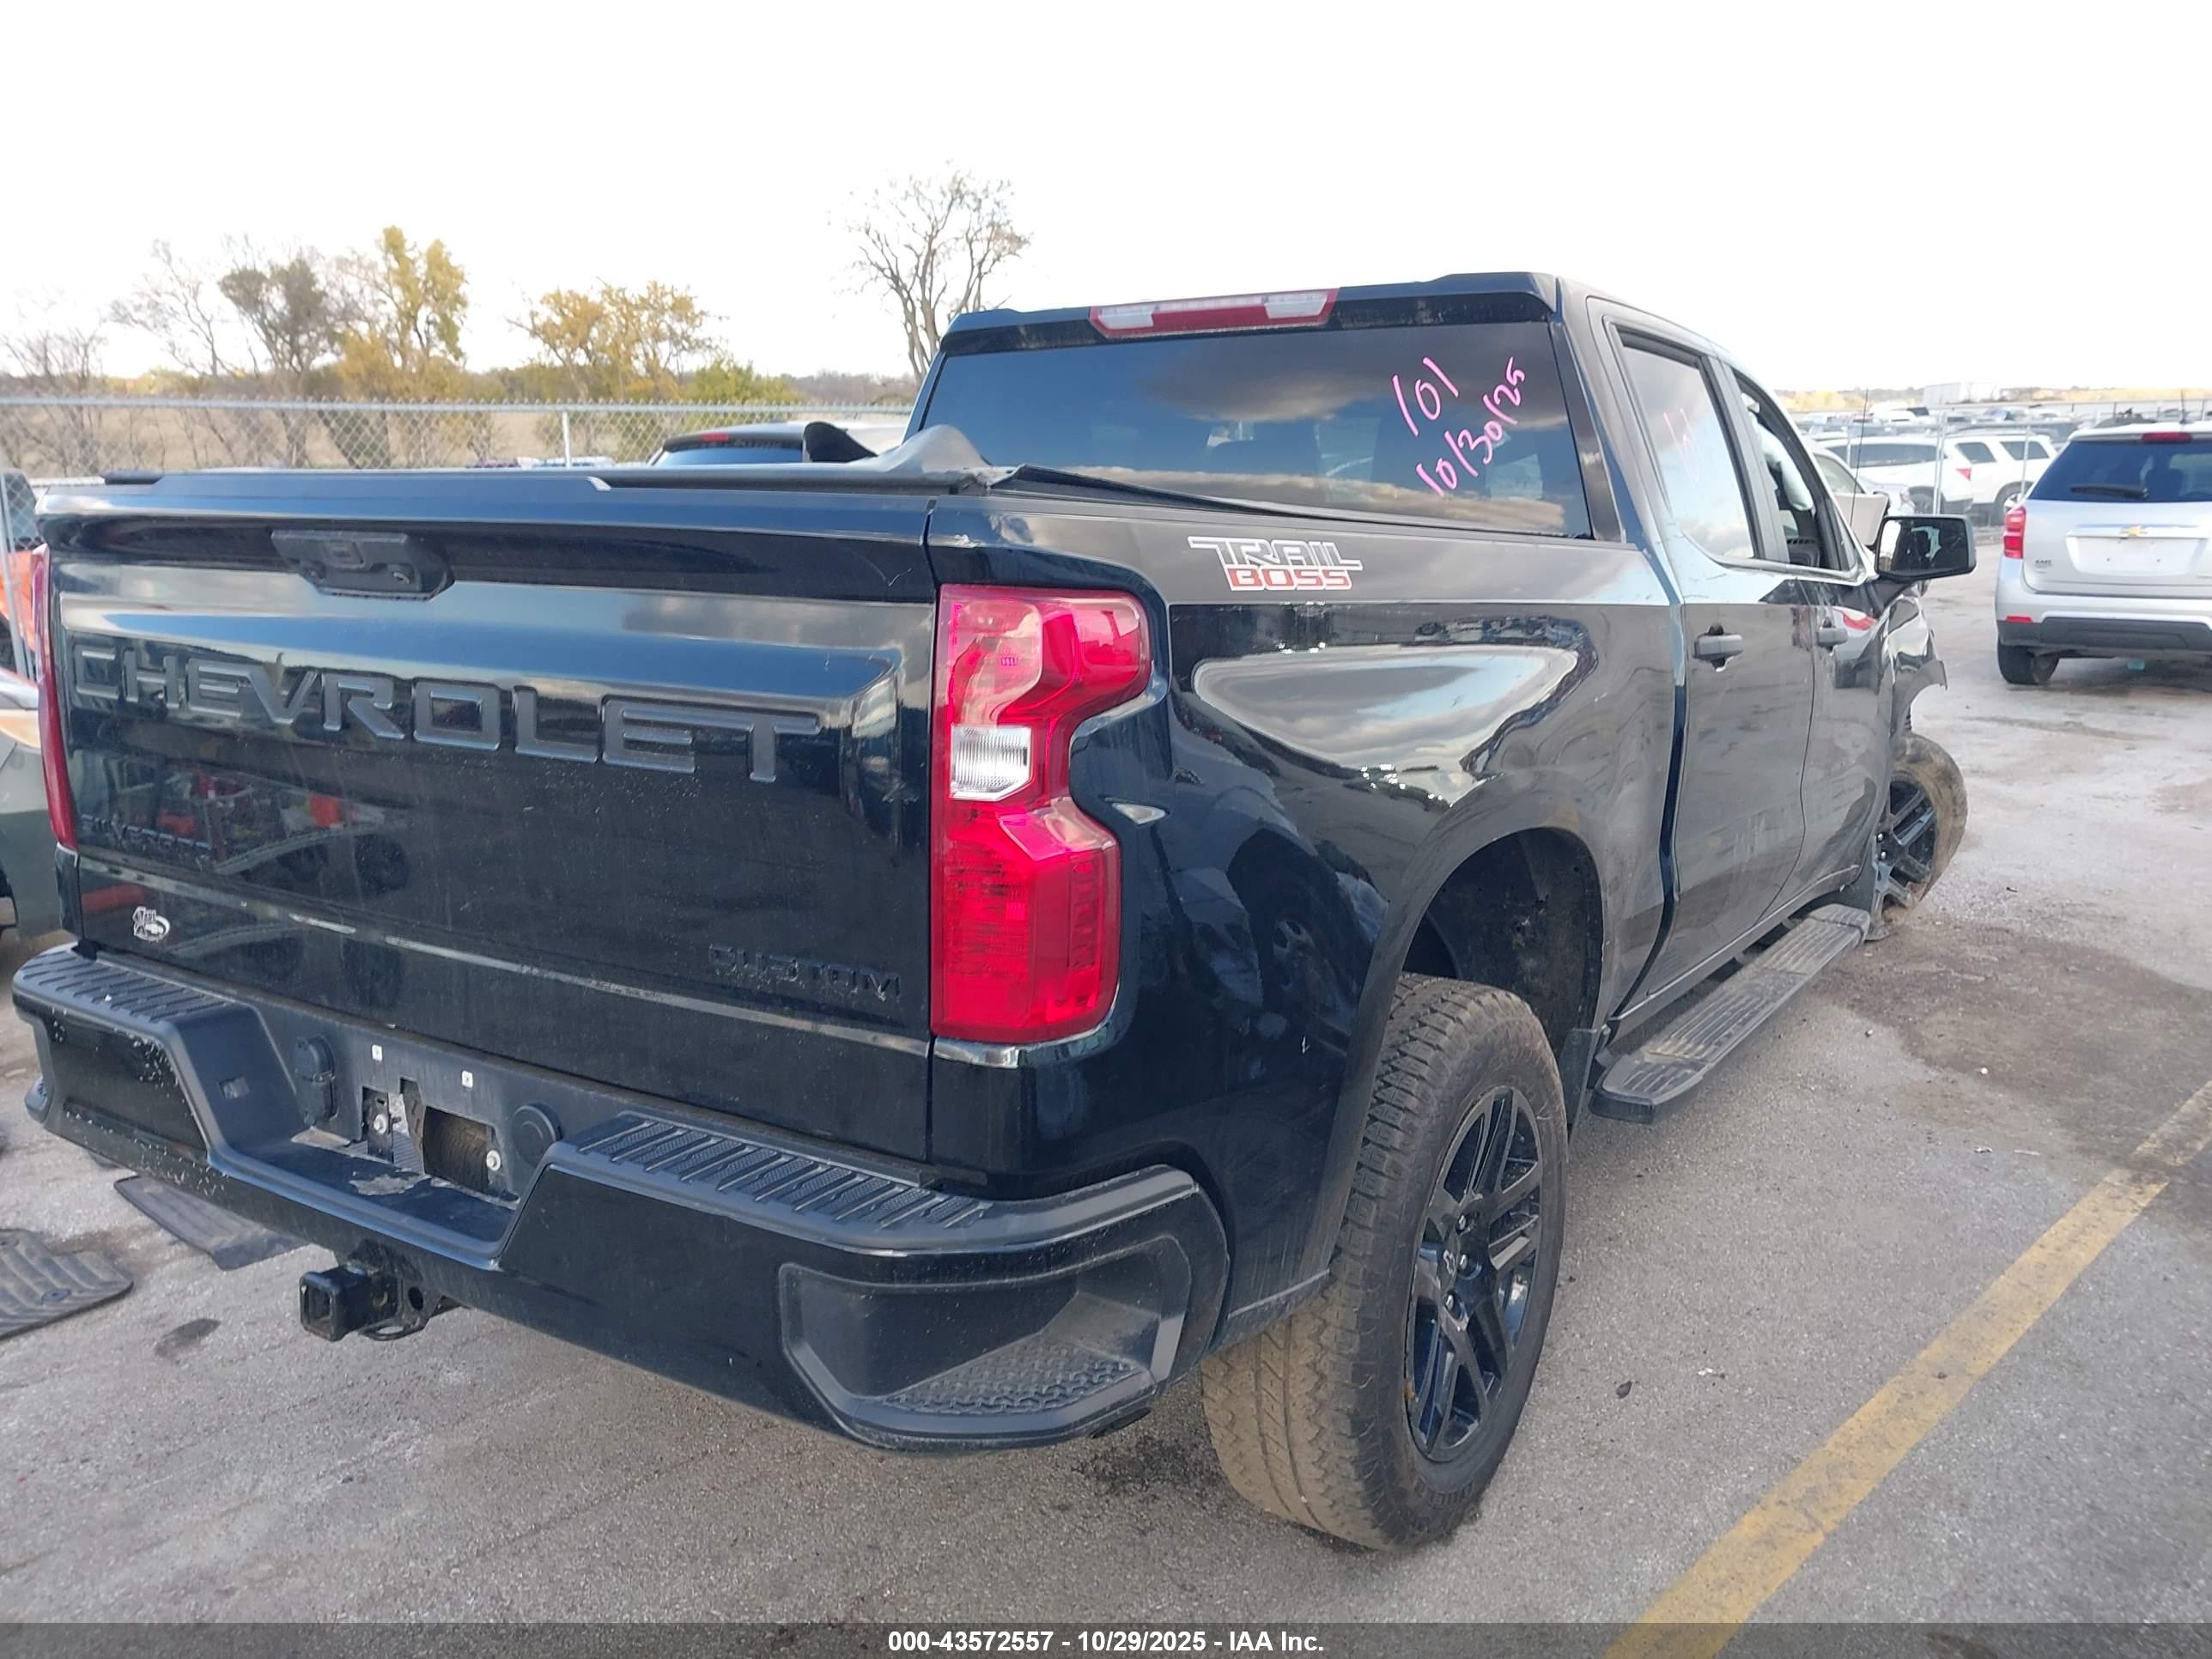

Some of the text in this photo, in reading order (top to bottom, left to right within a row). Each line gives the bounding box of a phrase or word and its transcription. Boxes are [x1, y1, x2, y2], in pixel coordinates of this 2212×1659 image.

[1392, 356, 1459, 436] 101
[1416, 356, 1525, 497] 10/30/25
[1188, 536, 1364, 570] TRAIL
[1225, 566, 1352, 591] BOSS
[72, 644, 820, 783] CHEVROLET
